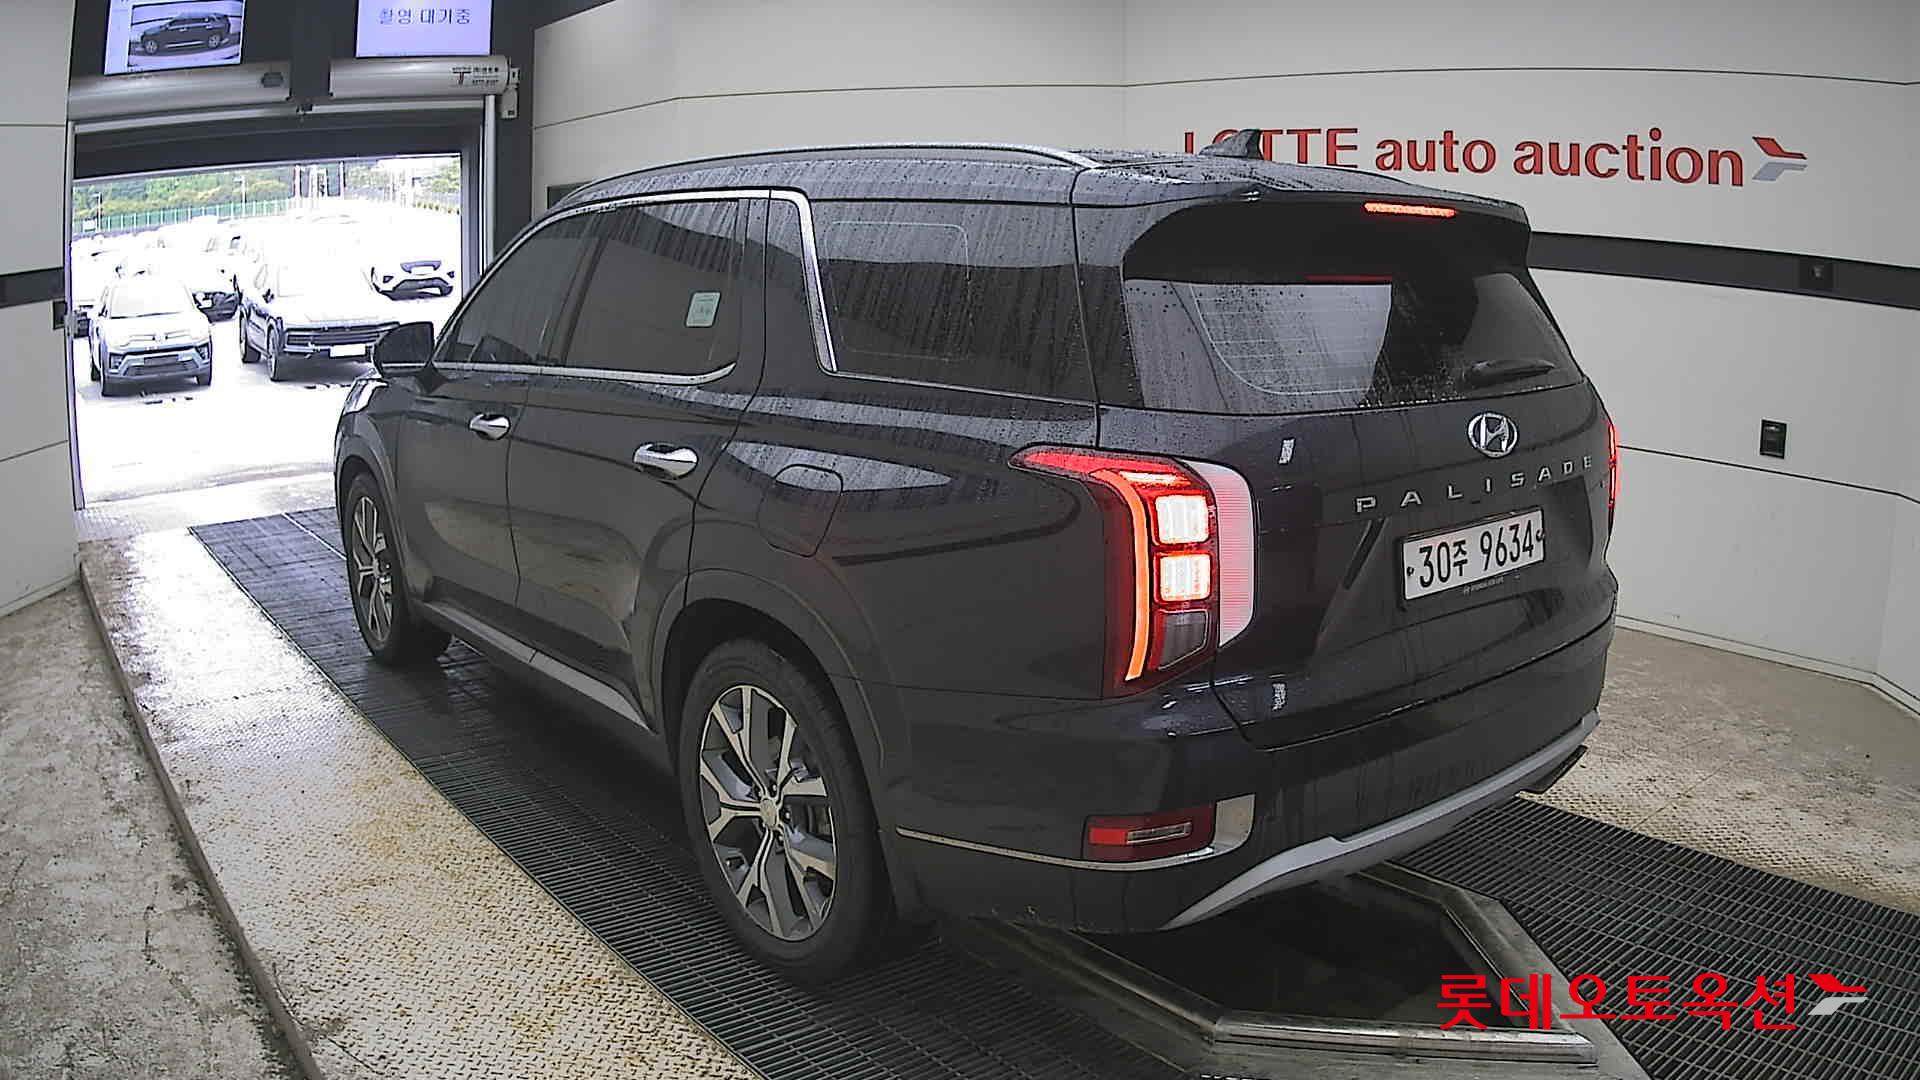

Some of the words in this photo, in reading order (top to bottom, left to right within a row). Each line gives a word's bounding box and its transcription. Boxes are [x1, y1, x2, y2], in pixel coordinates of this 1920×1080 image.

[420, 7, 472, 25] 대기중
[1184, 127, 1359, 168] TTE
[1375, 129, 1496, 174] auto
[1514, 126, 1744, 187] auction
[1355, 455, 1594, 513] PALISADE
[1419, 539, 1468, 588] 30주
[1479, 519, 1535, 572] 9634
